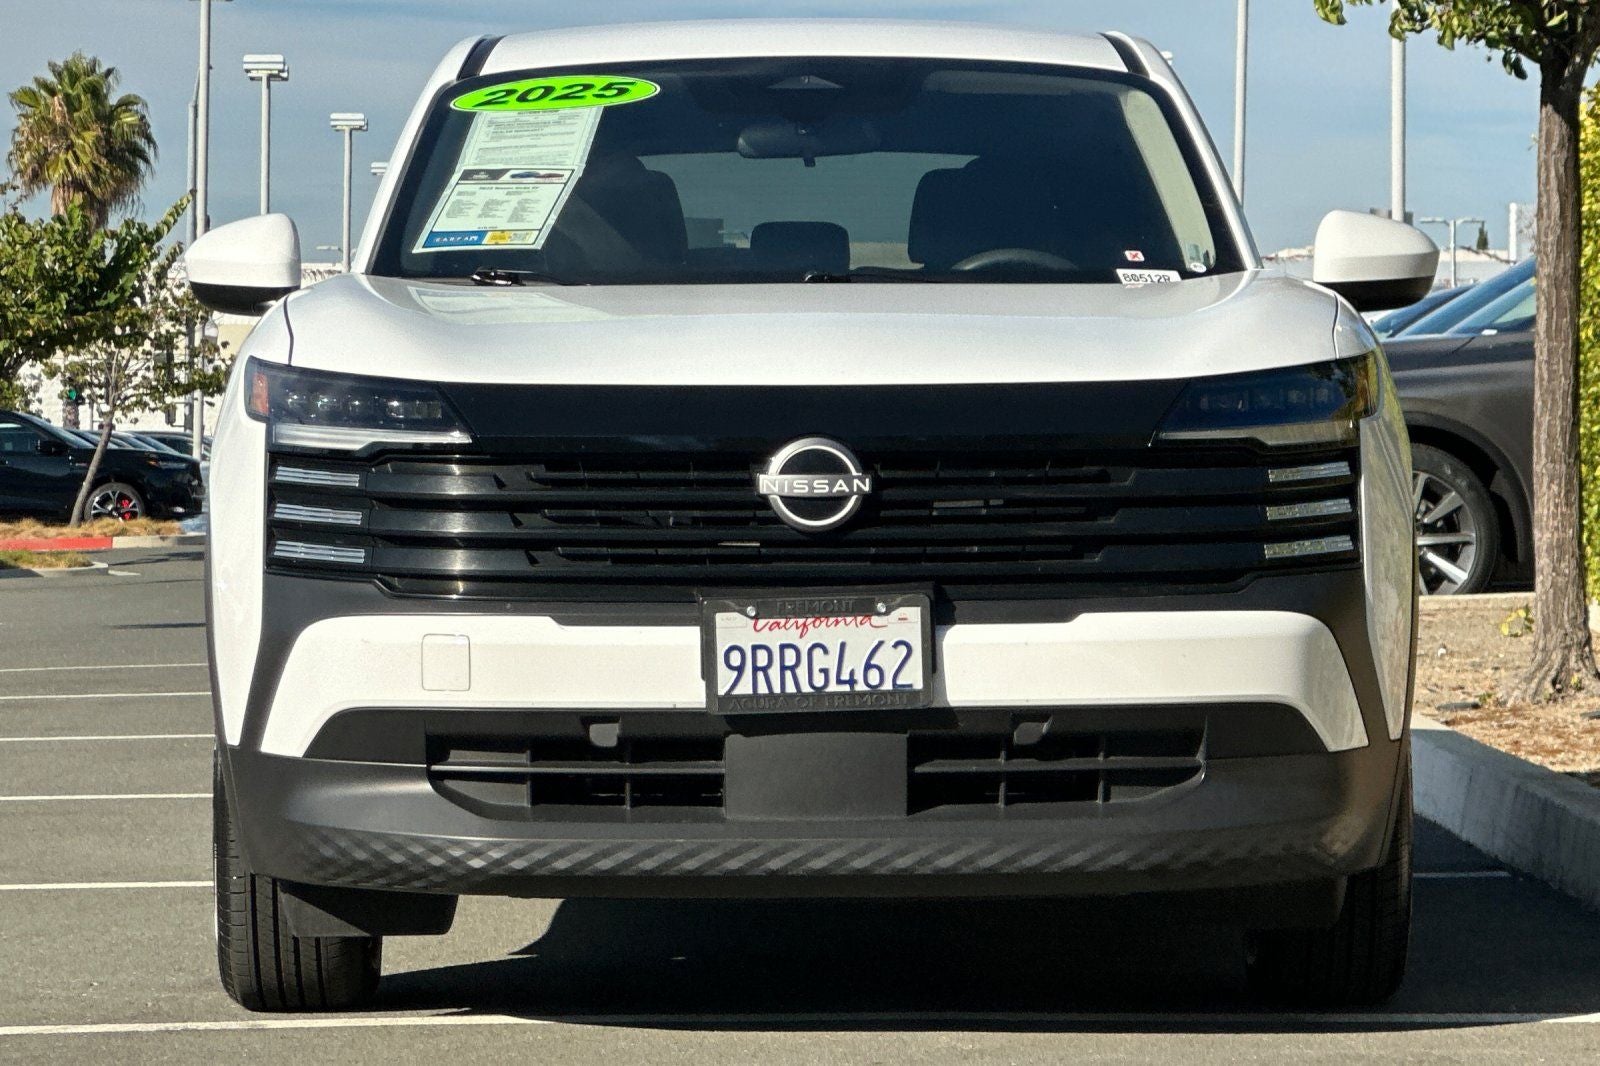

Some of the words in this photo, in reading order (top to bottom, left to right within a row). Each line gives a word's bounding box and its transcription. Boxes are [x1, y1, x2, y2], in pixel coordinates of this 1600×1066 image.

[472, 81, 637, 108] 2025
[763, 478, 870, 493] NISSAN
[752, 615, 889, 639] California
[722, 639, 914, 696] 9RRG462
